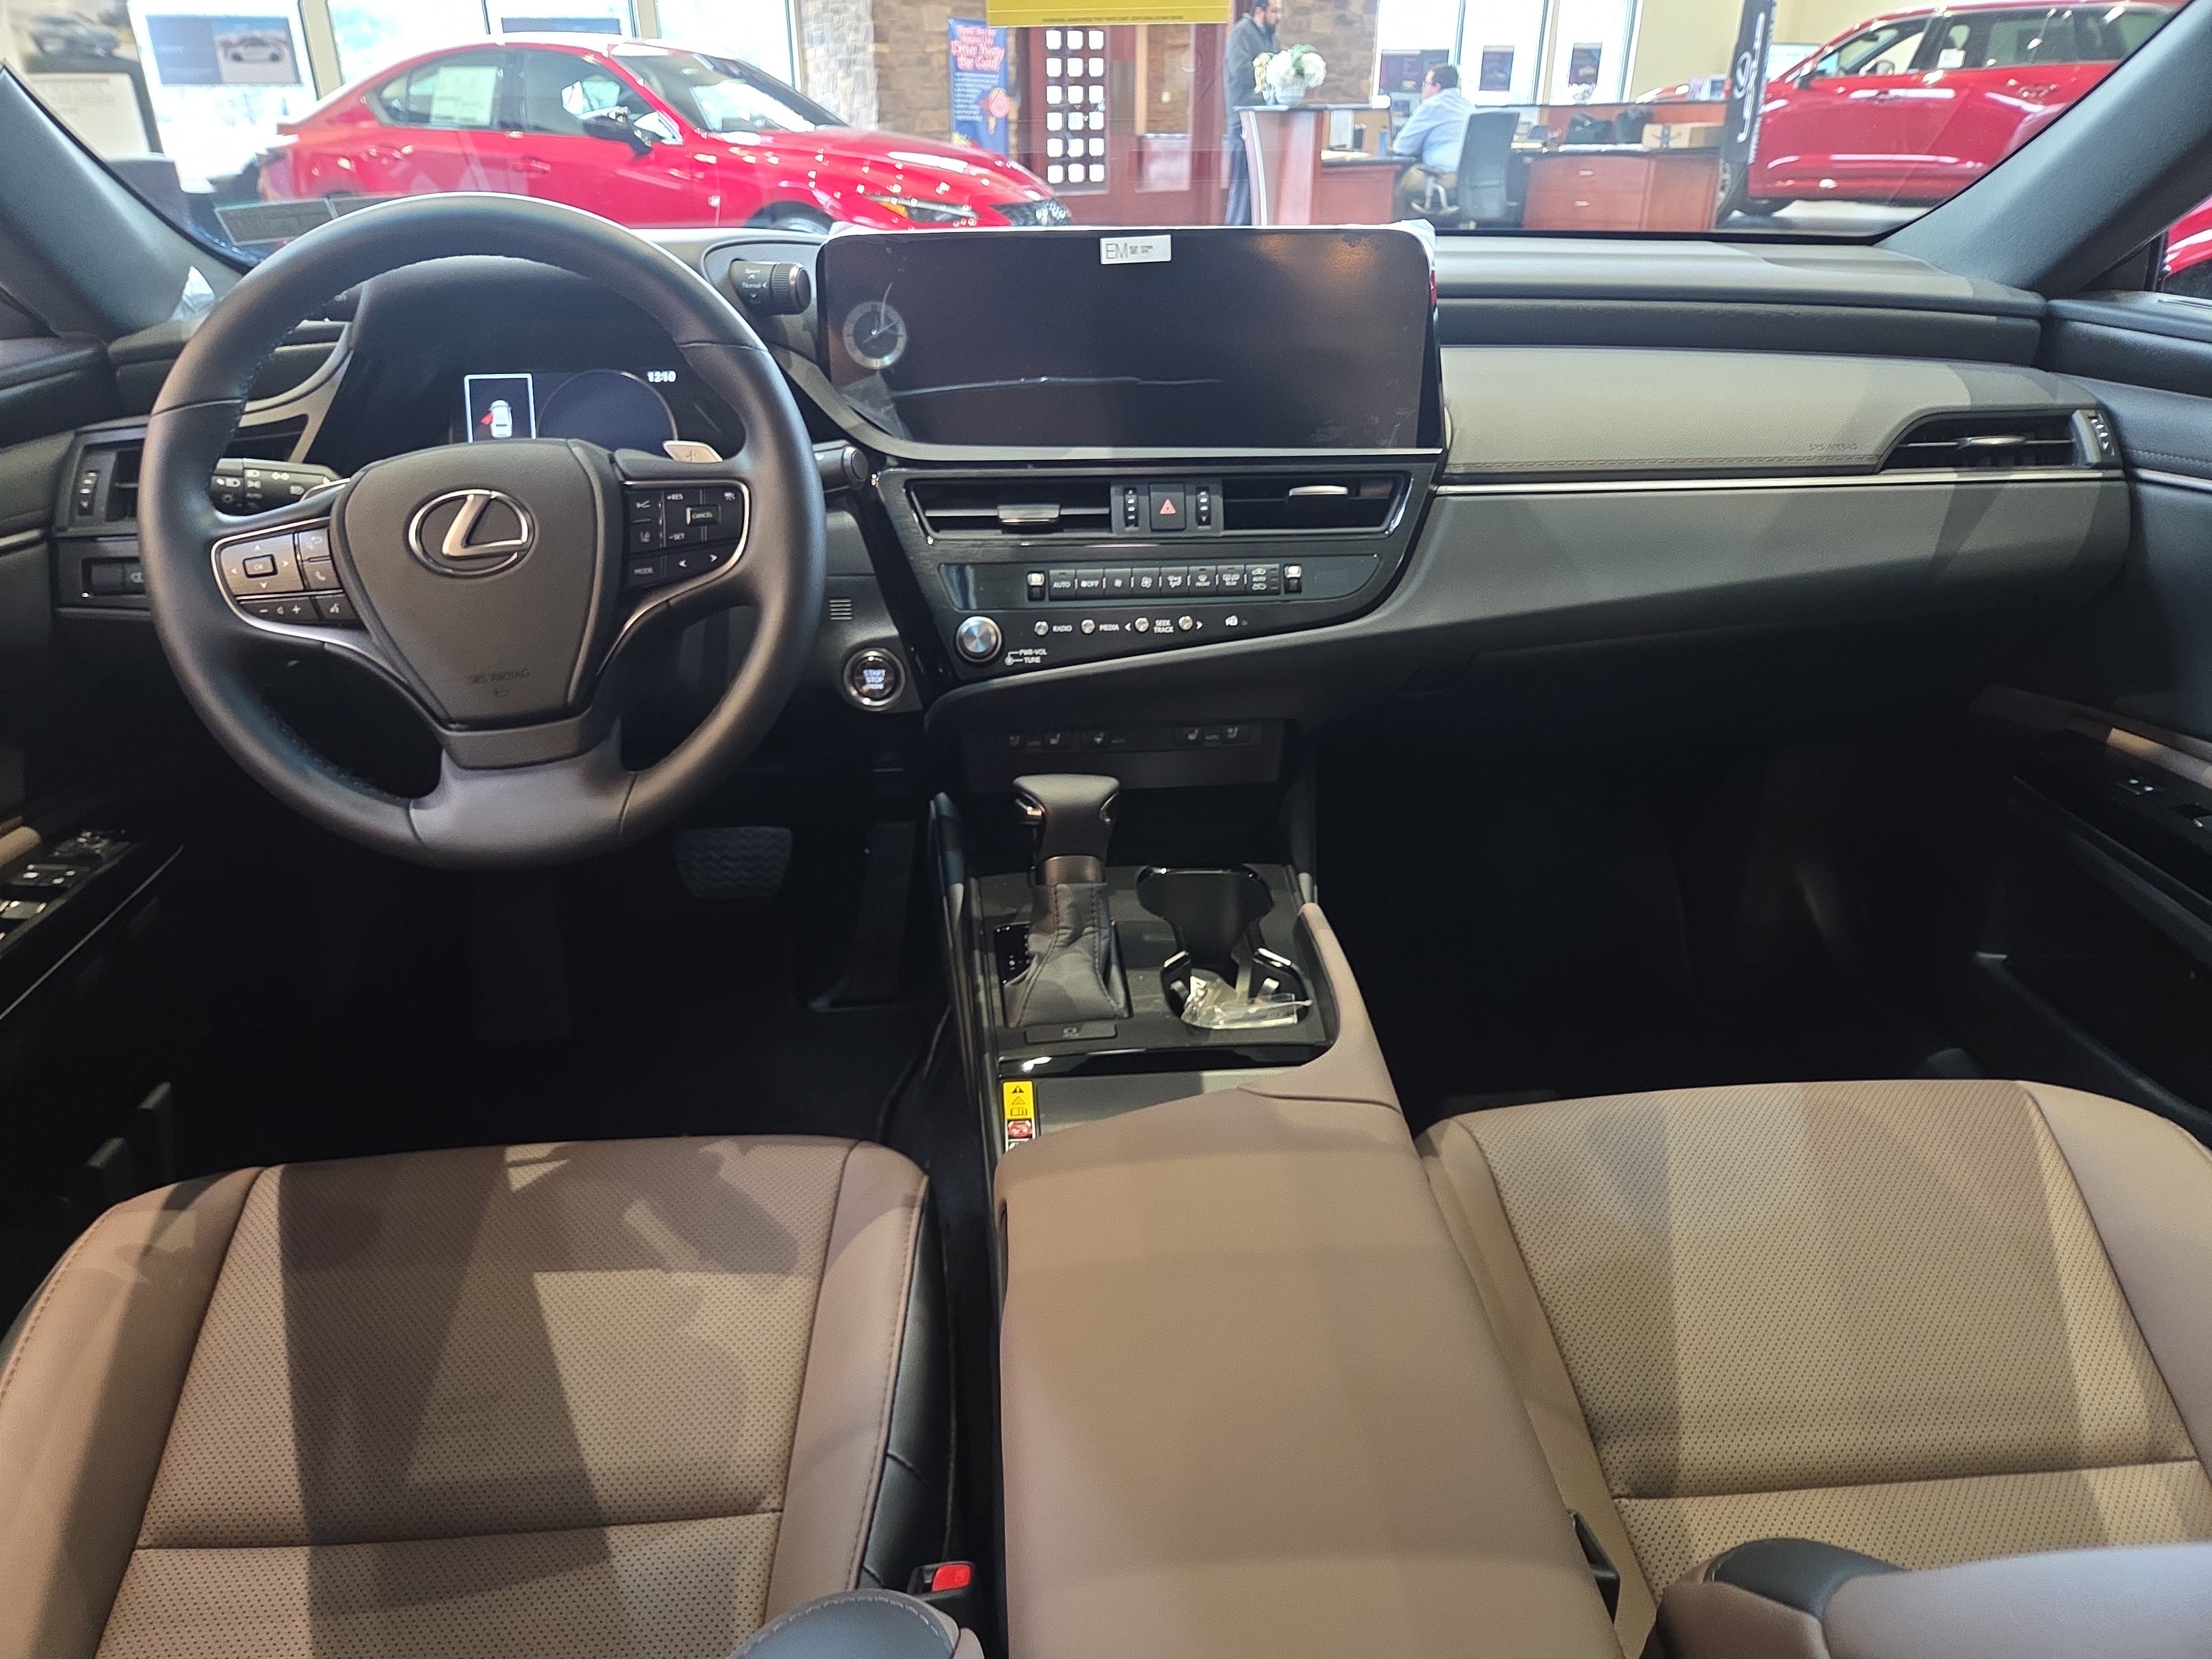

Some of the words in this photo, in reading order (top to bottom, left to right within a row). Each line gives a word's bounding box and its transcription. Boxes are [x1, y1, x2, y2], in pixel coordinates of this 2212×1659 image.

[647, 371, 677, 383] 12:10
[1099, 623, 1120, 632] MEDIA
[863, 669, 886, 678] START
